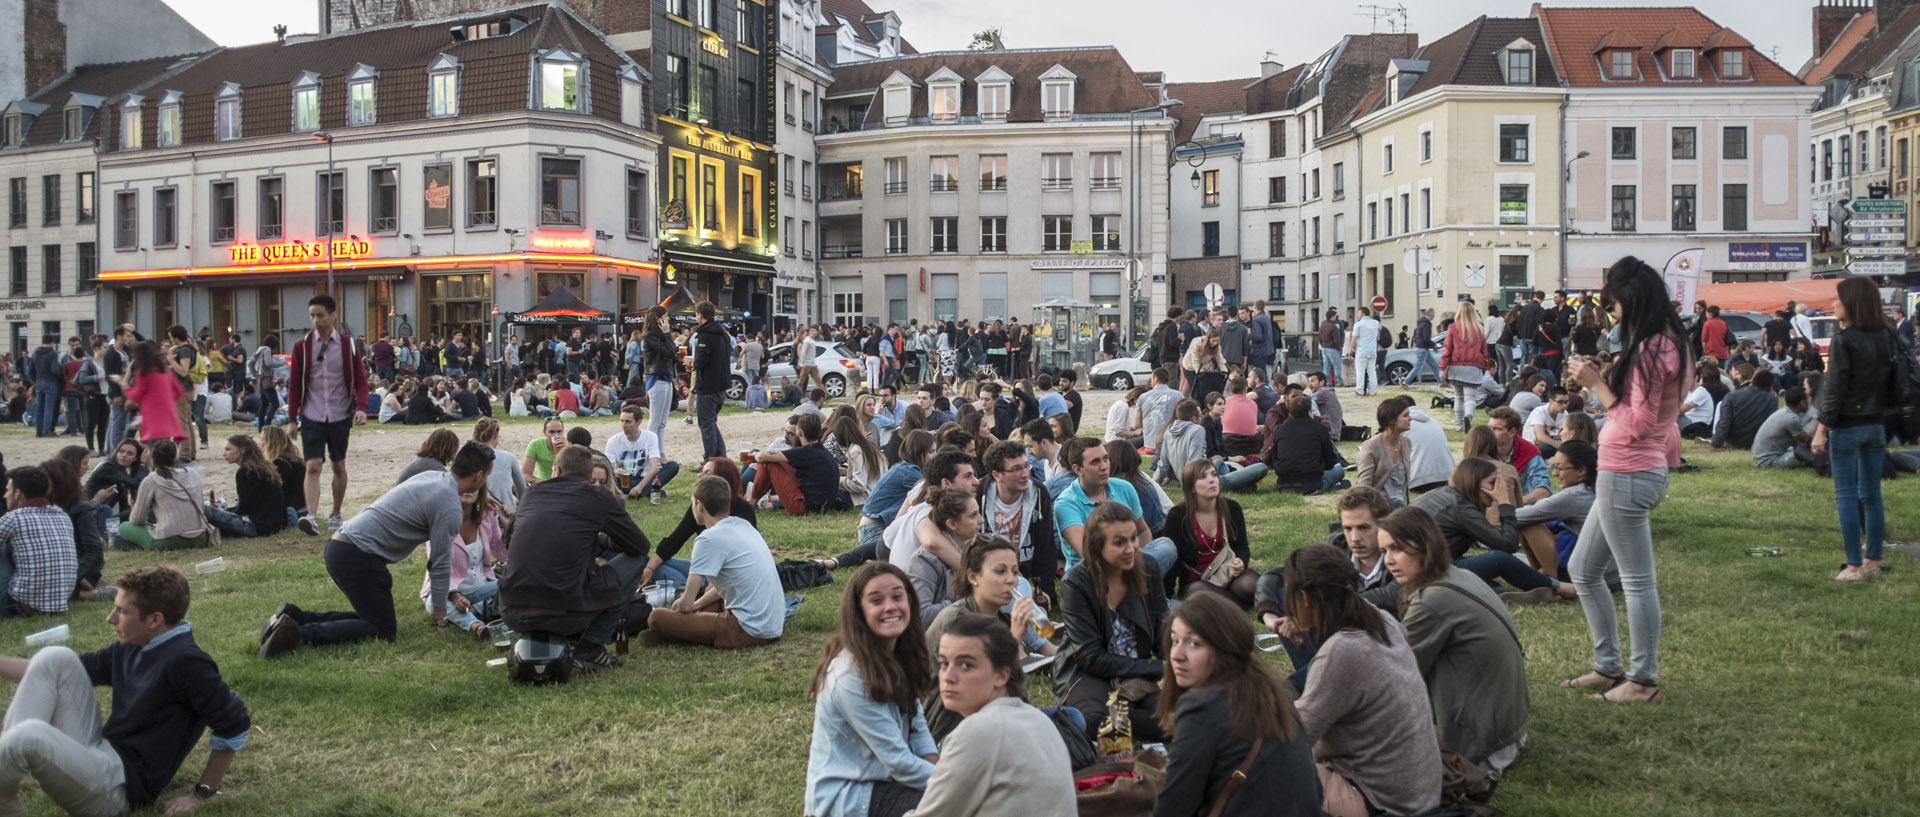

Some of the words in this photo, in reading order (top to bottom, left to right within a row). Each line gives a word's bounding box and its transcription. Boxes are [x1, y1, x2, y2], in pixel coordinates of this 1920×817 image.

[687, 135, 702, 147] THE
[702, 139, 740, 158] AUSTRALIAN
[769, 180, 776, 195] OZ
[230, 247, 257, 261] THE
[327, 241, 369, 256] HEAD
